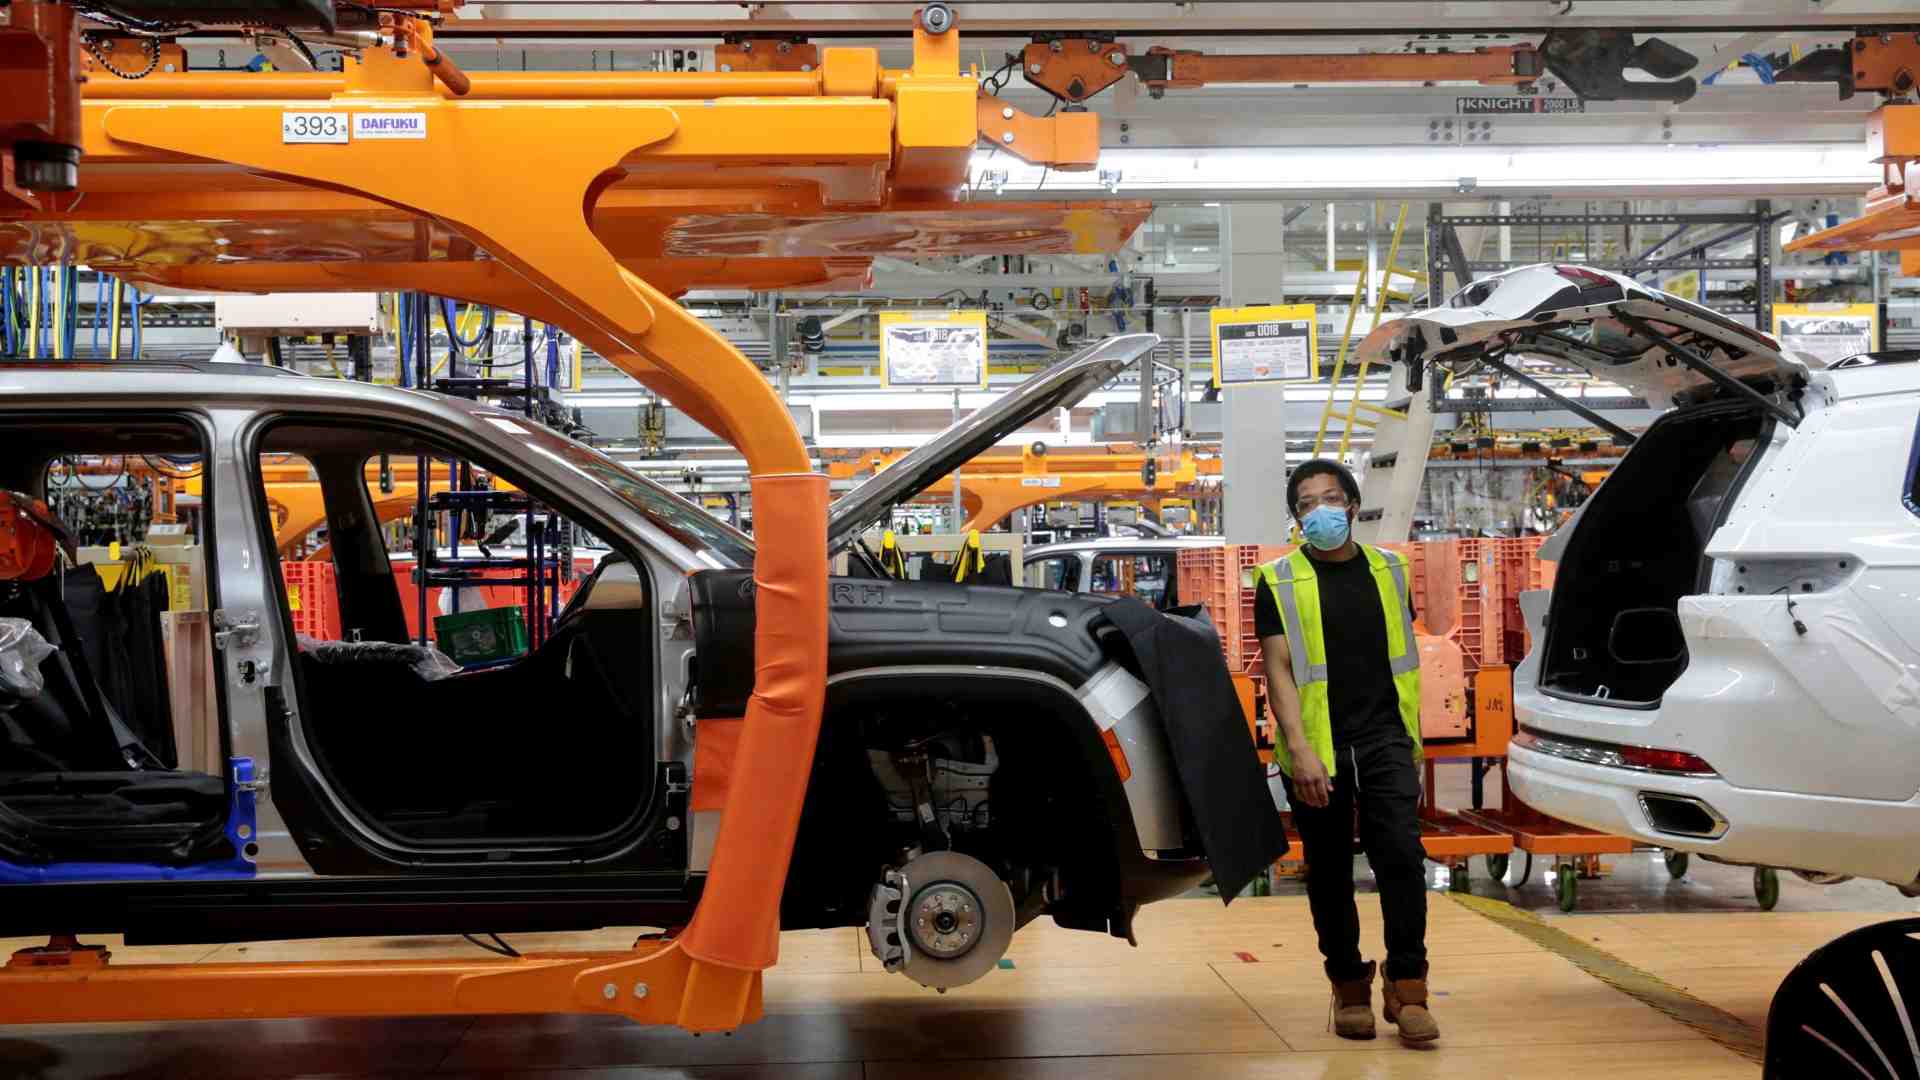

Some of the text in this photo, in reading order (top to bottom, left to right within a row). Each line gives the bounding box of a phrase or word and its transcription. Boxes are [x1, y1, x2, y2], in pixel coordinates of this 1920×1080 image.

[1466, 98, 1532, 109] KNIGHT
[294, 116, 337, 136] 393
[361, 118, 418, 129] DAIFUKU
[832, 582, 884, 604] RH
